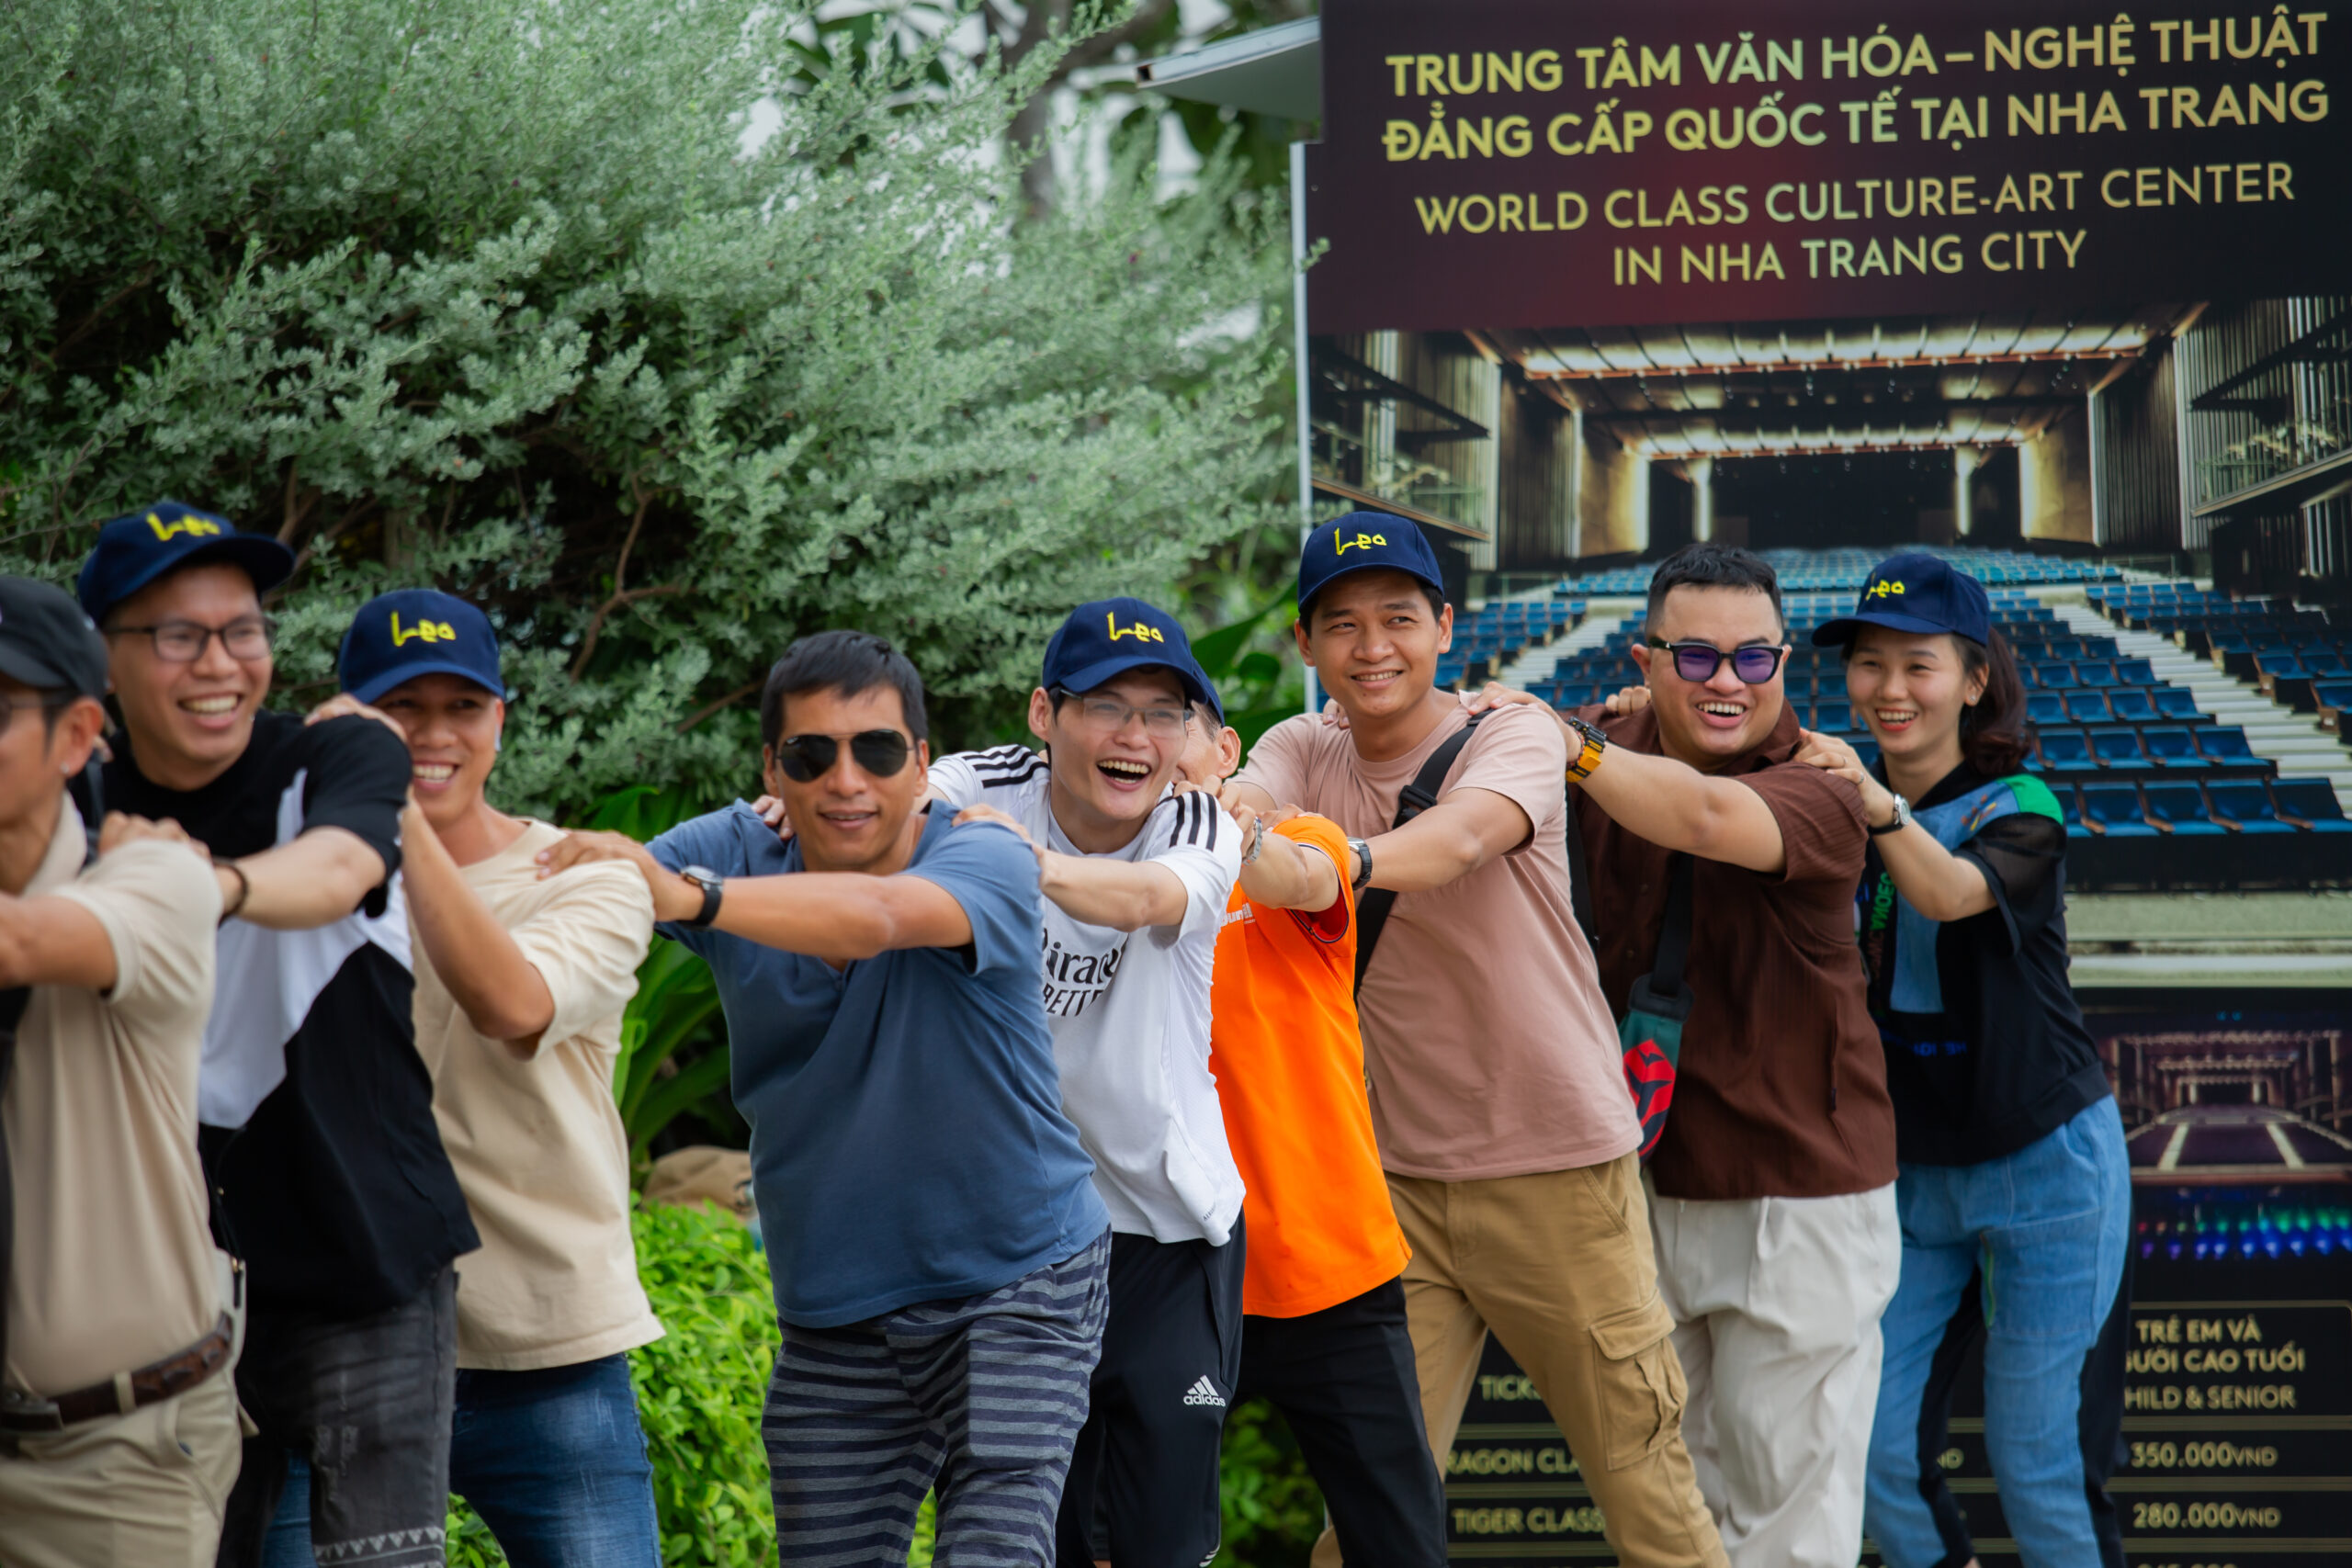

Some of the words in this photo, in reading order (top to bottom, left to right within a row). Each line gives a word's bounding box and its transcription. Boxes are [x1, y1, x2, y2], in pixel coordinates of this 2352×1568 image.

[1385, 50, 1562, 96] TRUNG
[1577, 38, 1679, 89] TÂM
[1695, 32, 1803, 84] VĂN
[1822, 25, 1938, 79] HÓA
[1985, 14, 2135, 76] NGHỆ
[2150, 5, 2327, 68] THUẬT
[1382, 101, 1532, 161] ĐẲNG
[1547, 98, 1652, 155] CẤP
[1666, 92, 1826, 151] QUỐC
[1839, 86, 1902, 143] TẾ
[1911, 96, 1987, 151] TẠI
[2008, 91, 2126, 136] NHA
[2139, 80, 2327, 130] TRANG
[1415, 192, 1588, 233] WORLD
[1605, 186, 1748, 228] CLASS
[1766, 172, 2083, 222] CULTURE-ART
[2101, 163, 2293, 208] CENTER
[1615, 247, 1661, 285] IN
[1681, 243, 1784, 283] NHA
[1801, 235, 1962, 278] TRANG
[1982, 230, 2086, 271] CITY
[2187, 1320, 2222, 1342] EM
[2184, 1349, 2239, 1371] CAO
[1183, 1393, 1227, 1407] adidas
[1479, 1375, 1543, 1401] TICK
[2124, 1386, 2181, 1409] HILD
[2186, 1386, 2203, 1408] &
[2208, 1385, 2295, 1408] SENIOR
[1446, 1448, 1533, 1475] RAGON
[1453, 1508, 1522, 1533] TIGER
